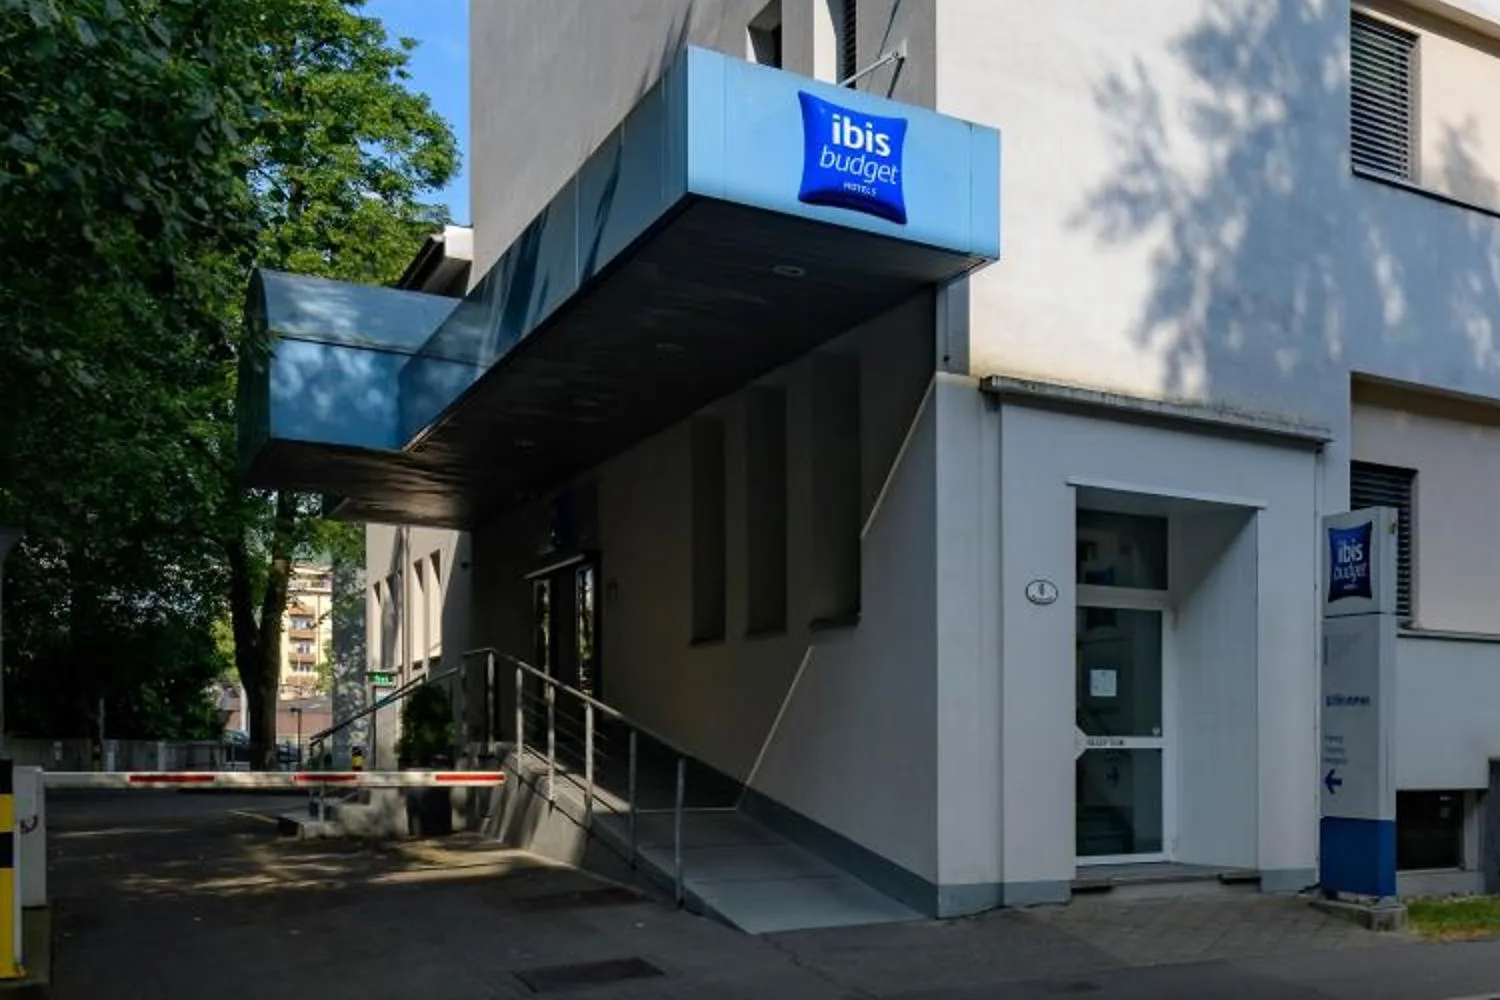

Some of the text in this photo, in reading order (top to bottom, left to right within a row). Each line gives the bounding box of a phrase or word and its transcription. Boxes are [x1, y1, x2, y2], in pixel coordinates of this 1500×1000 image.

[832, 114, 891, 157] ibis
[819, 145, 898, 185] budget
[1338, 537, 1363, 562] ibis
[1333, 559, 1366, 582] budget
